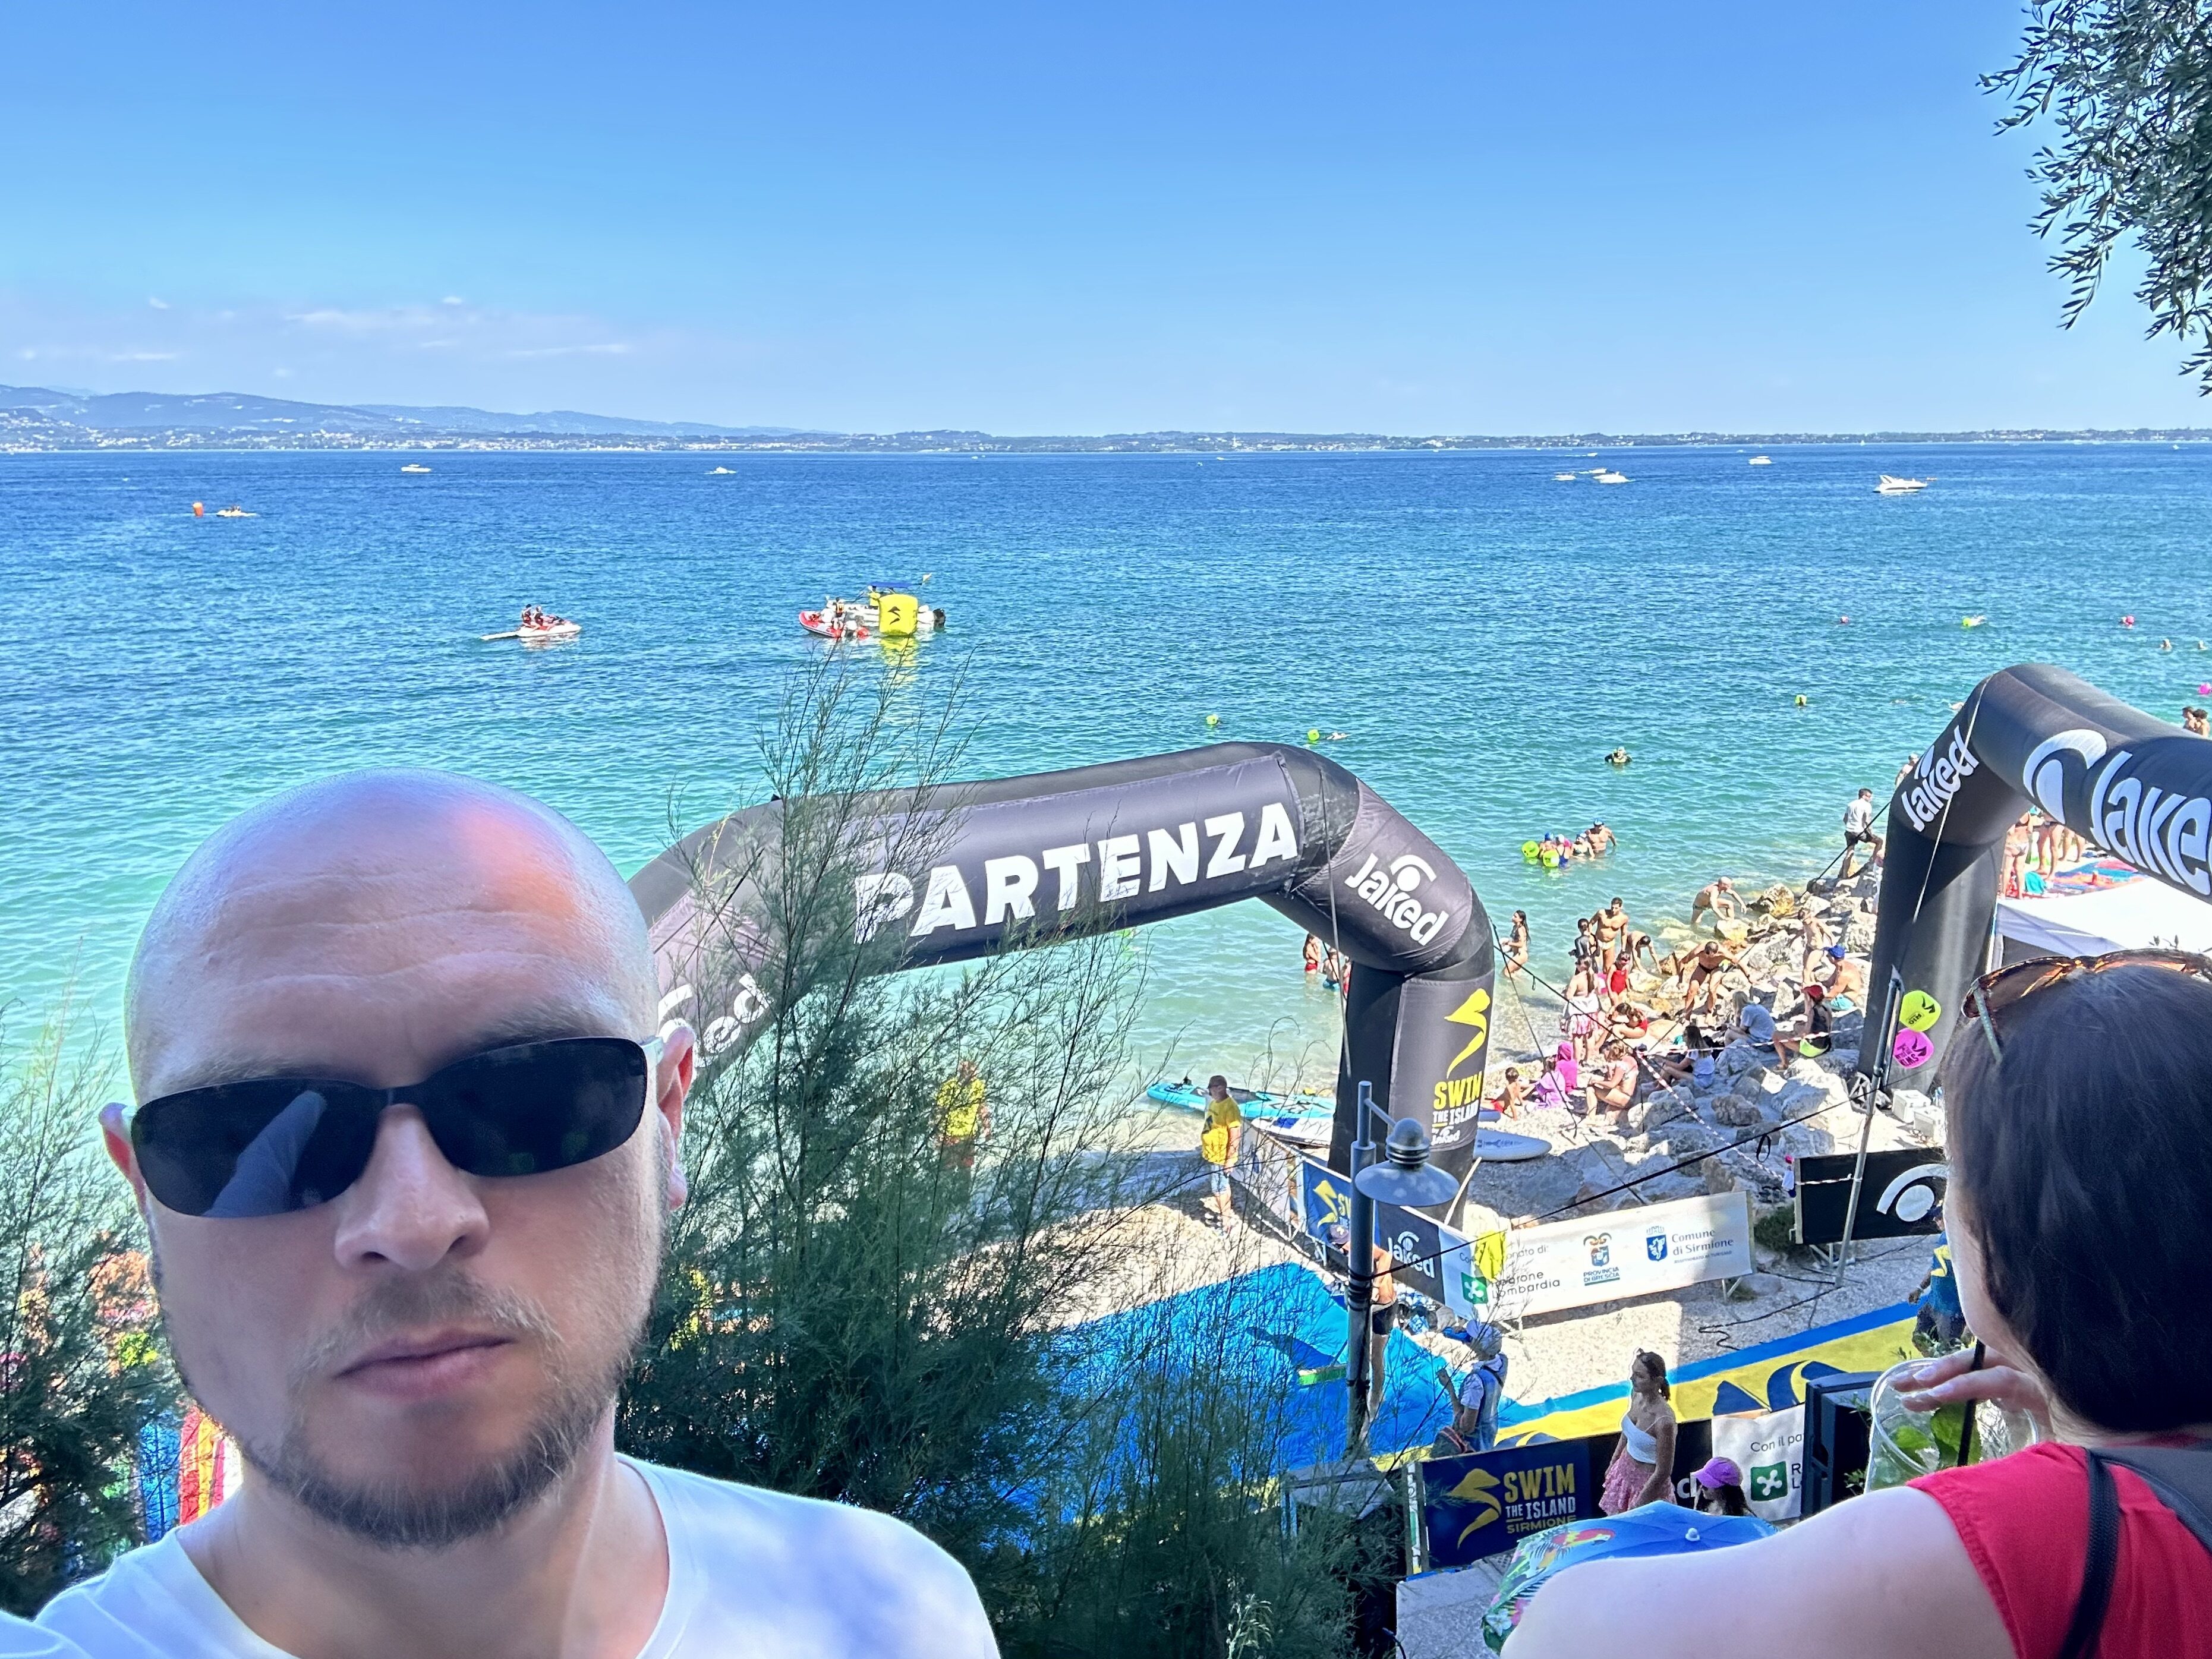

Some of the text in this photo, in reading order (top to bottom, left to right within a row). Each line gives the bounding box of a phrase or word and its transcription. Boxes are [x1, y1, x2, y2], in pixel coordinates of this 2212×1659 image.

[2090, 750, 2212, 895] Jake
[854, 802, 1297, 944] PARTENZA
[1344, 853, 1450, 946] Jaked
[1433, 1070, 1482, 1110] SWIM
[1433, 1110, 1449, 1123] THE
[1672, 1229, 1715, 1242] Comune
[1673, 1239, 1734, 1256] di Sirmione
[1583, 1266, 1619, 1277] PROVINCIA
[1751, 1441, 1775, 1452] Con
[1778, 1435, 1784, 1447] il
[1504, 1464, 1575, 1503] SWIM
[1505, 1496, 1576, 1520] THE ISLAND
